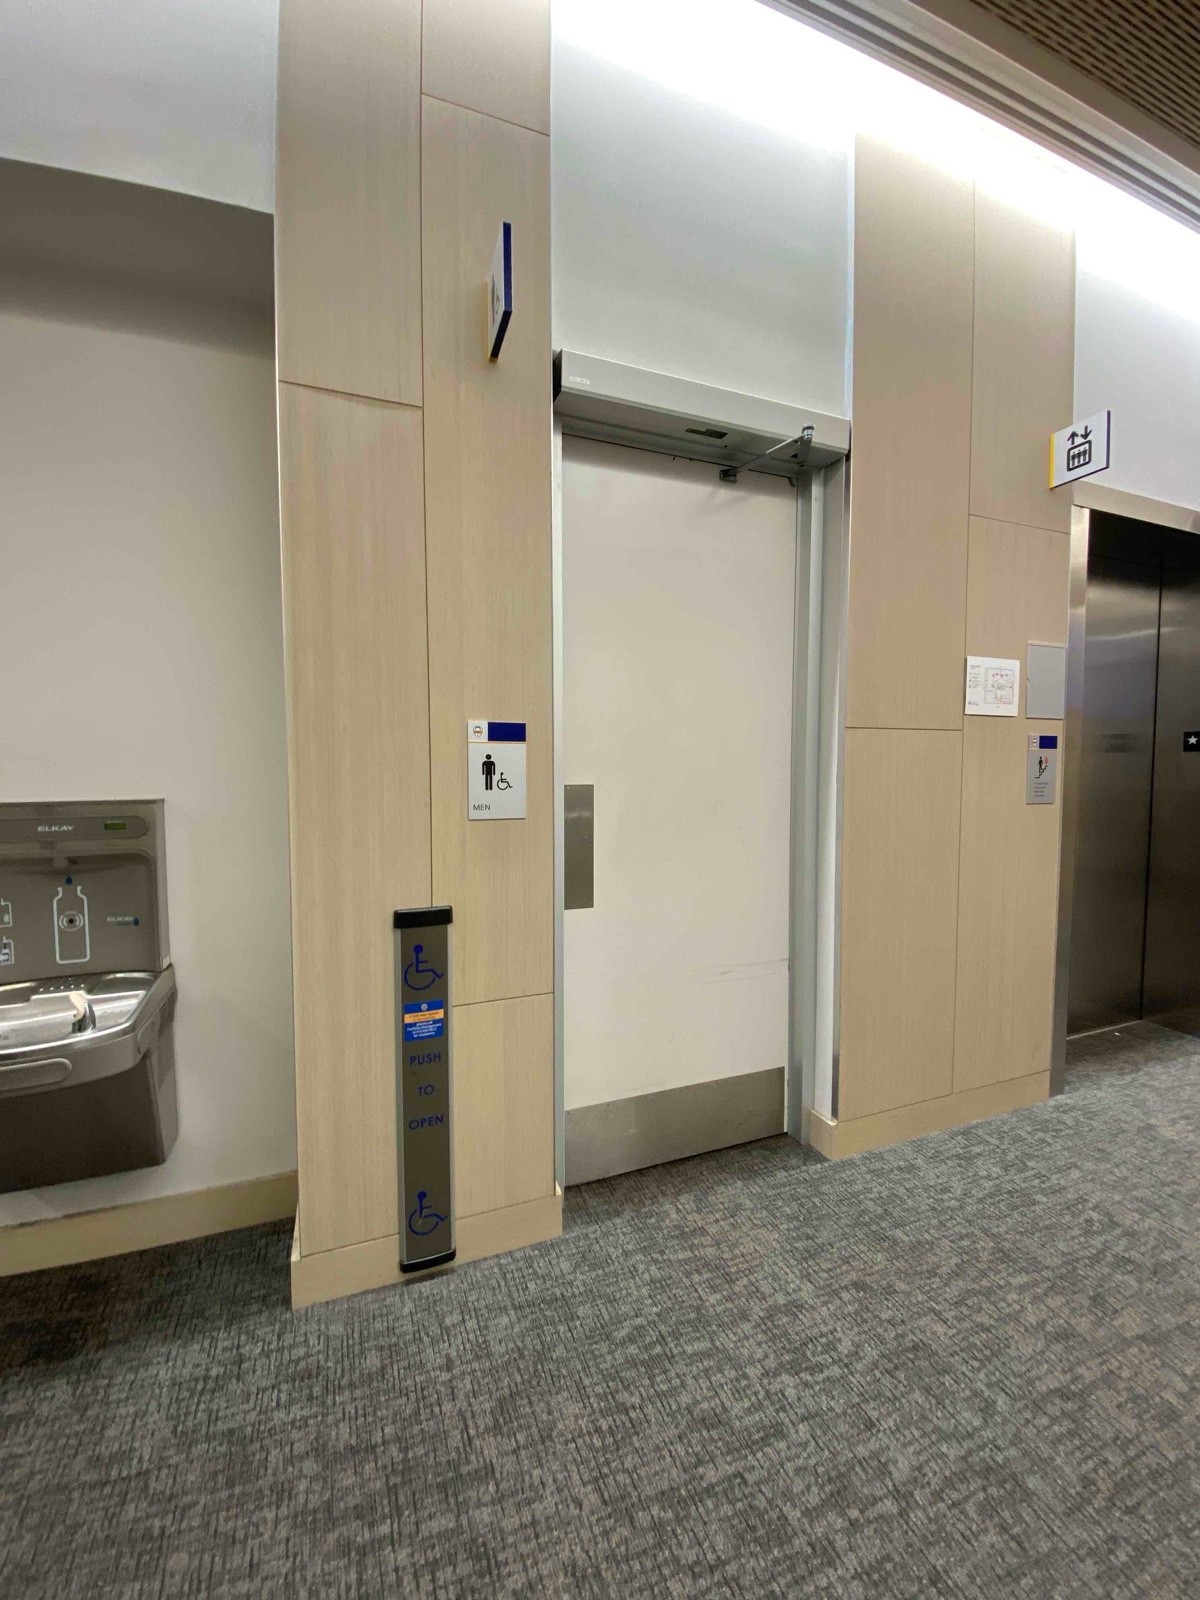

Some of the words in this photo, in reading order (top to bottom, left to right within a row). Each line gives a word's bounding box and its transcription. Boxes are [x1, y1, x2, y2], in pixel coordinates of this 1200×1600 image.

[409, 1052, 441, 1066] PUSH
[417, 1084, 435, 1096] TO
[408, 1114, 444, 1130] OPEN
